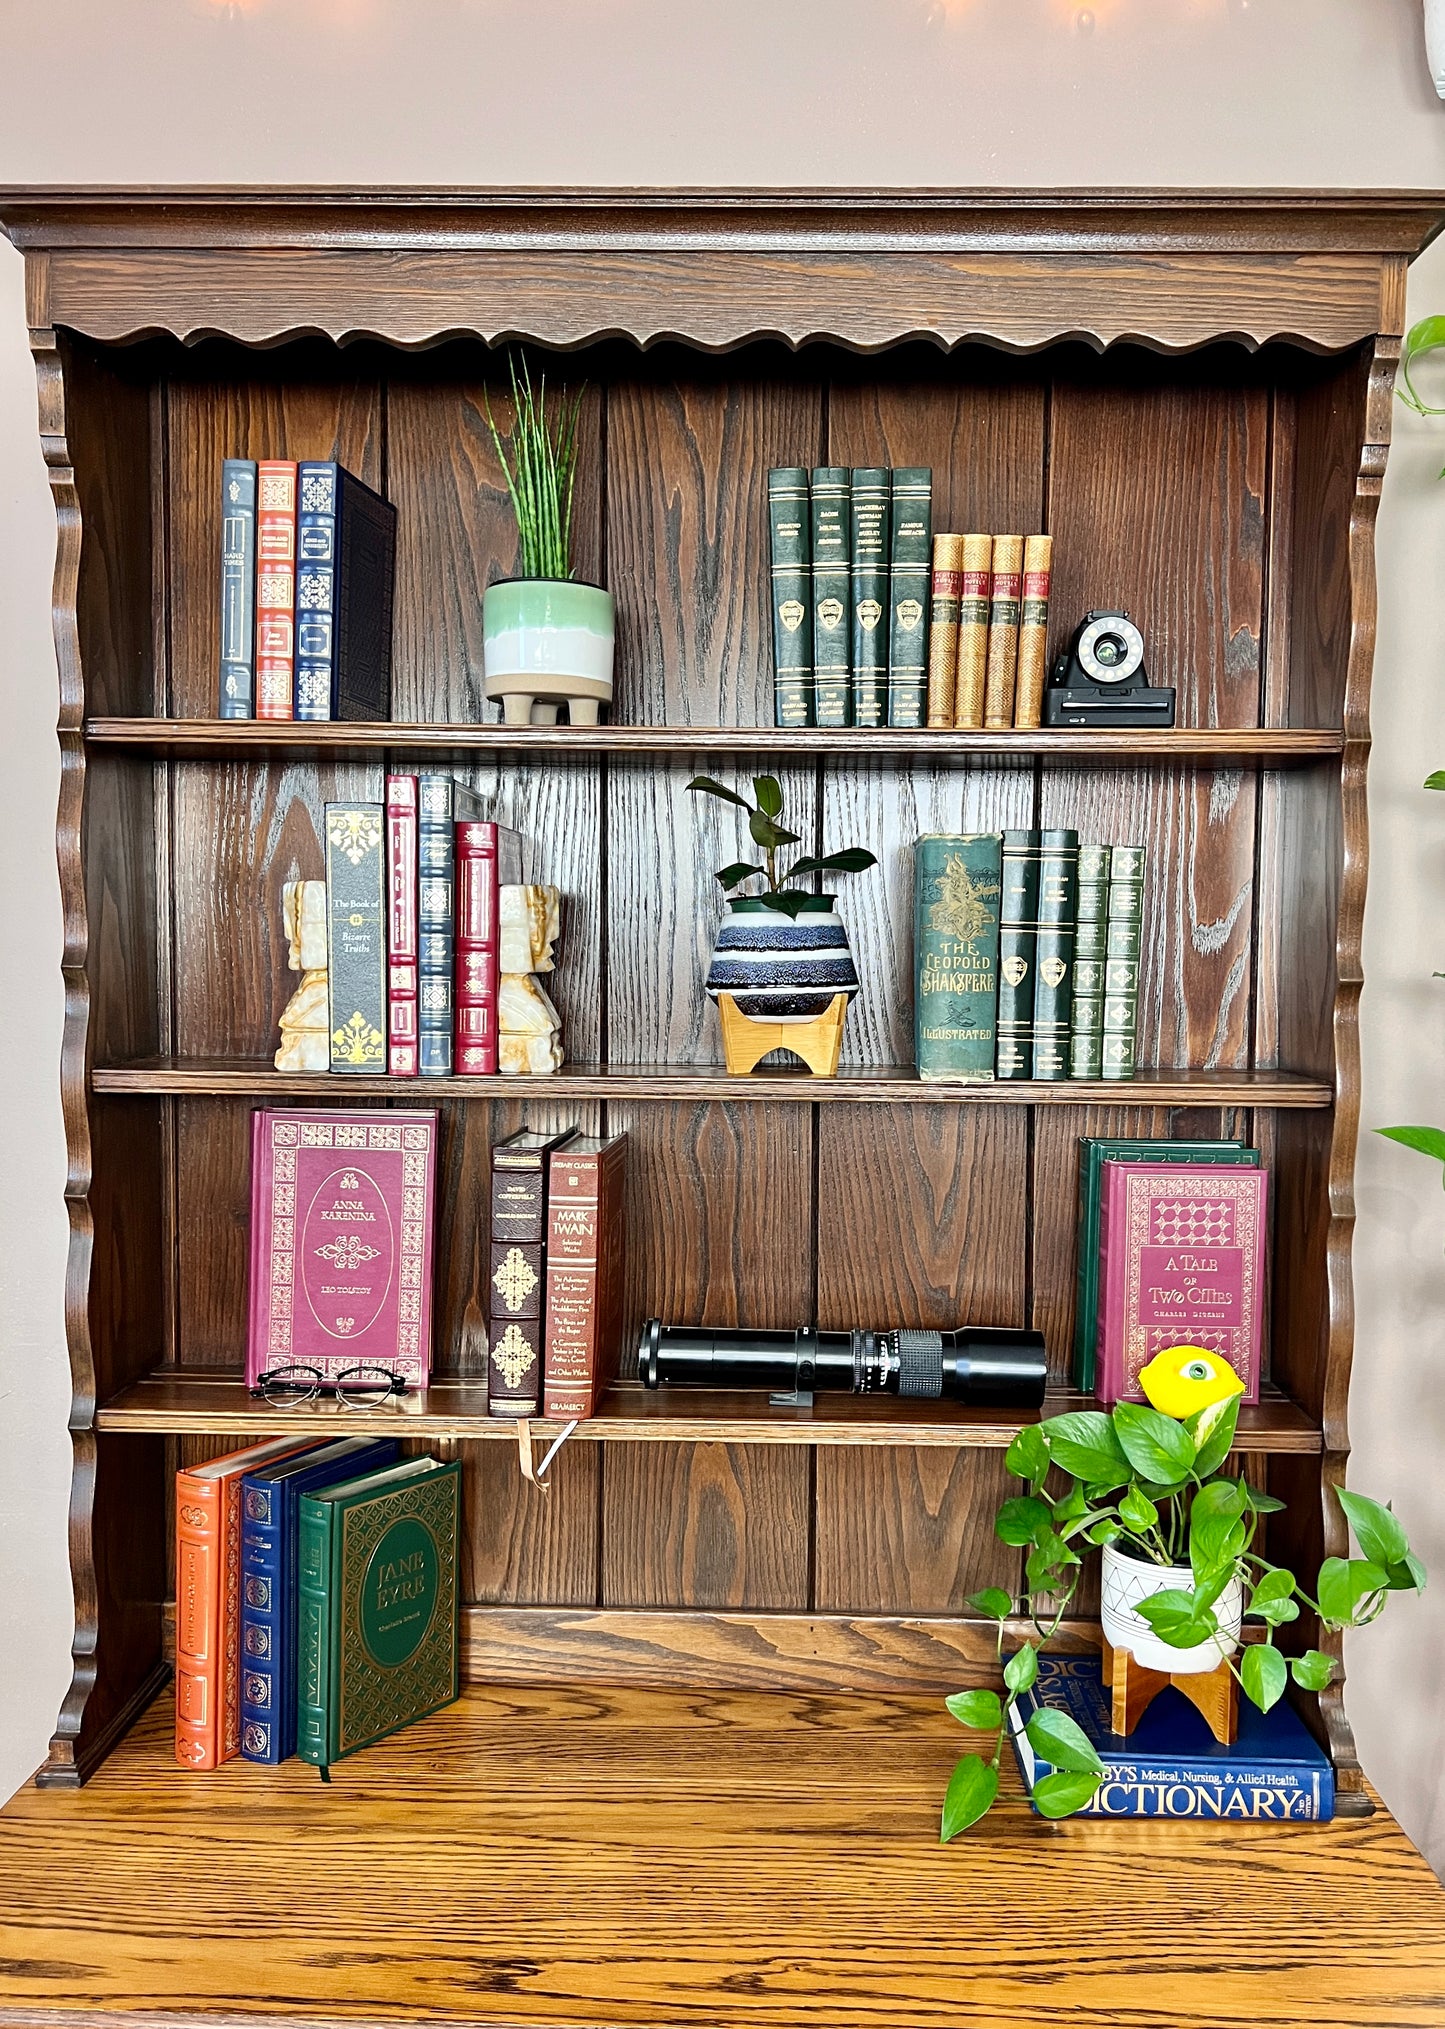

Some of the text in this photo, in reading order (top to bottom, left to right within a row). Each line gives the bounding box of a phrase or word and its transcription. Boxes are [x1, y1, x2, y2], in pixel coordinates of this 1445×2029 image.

[332, 900, 380, 908] The Book of
[342, 932, 371, 940] Bizarre
[343, 943, 370, 952] Truths
[940, 942, 980, 956] THE
[926, 952, 990, 972] LEOPOLD
[922, 970, 994, 996] SHAKSPERE
[923, 1026, 992, 1040] ILLUSTRATED
[573, 1162, 598, 1170] CLASSICS
[332, 1200, 365, 1210] ANNA
[320, 1210, 376, 1222] KARENINA
[557, 1210, 589, 1222] MARK
[552, 1222, 594, 1236] TWAIN
[562, 1238, 583, 1246] Selected
[1164, 1256, 1180, 1271] A
[320, 1286, 372, 1294] LEO TOLSTOY
[1153, 1310, 1187, 1318] CHARLES
[551, 1338, 558, 1346] A
[557, 1368, 572, 1376] Other
[376, 1550, 425, 1590] JANE
[376, 1574, 425, 1611] EYRE
[1141, 1769, 1181, 1784] Medical,
[1182, 1771, 1223, 1785] Nursing,
[1224, 1772, 1235, 1784] &
[1236, 1773, 1266, 1785] Allied
[1266, 1774, 1299, 1786] Health
